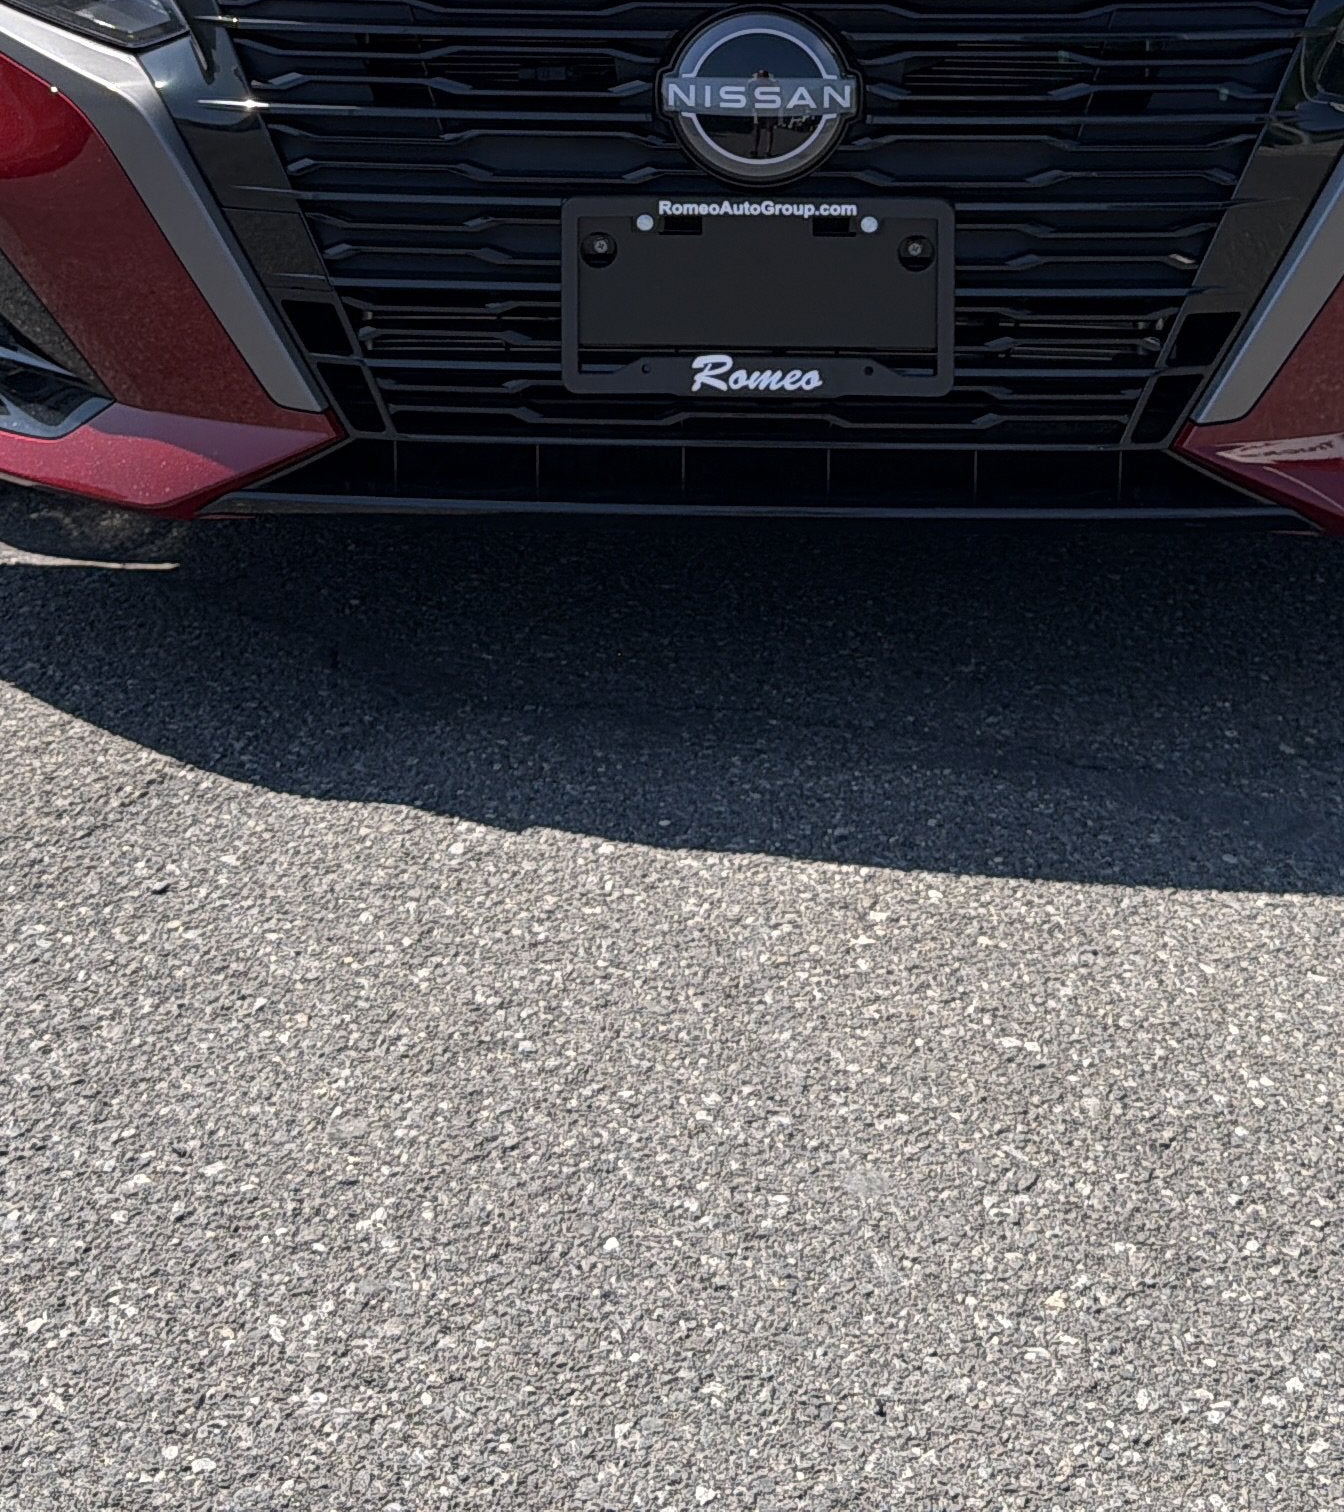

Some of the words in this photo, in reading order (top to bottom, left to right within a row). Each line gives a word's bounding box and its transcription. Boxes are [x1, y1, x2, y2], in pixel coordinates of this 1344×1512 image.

[667, 83, 851, 109] NISSAN
[658, 200, 858, 218] RomeoAutoGroup.com
[691, 354, 823, 392] Romeo
